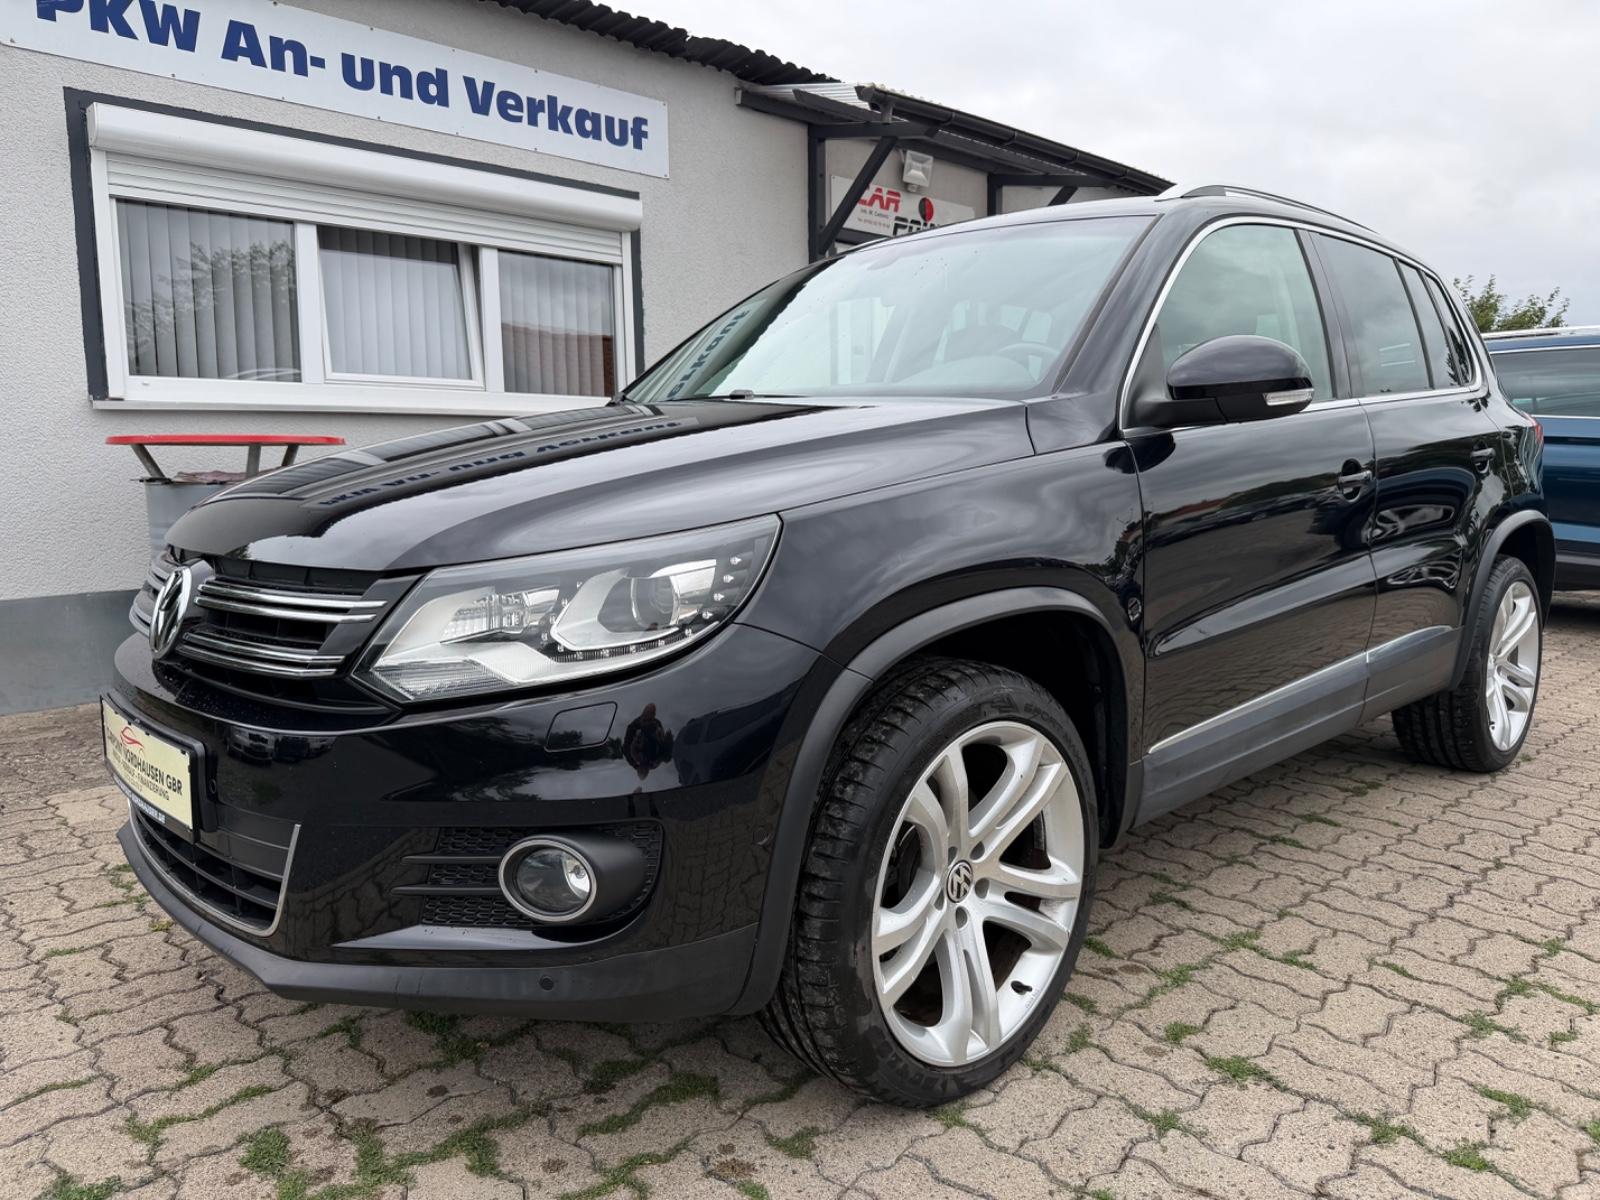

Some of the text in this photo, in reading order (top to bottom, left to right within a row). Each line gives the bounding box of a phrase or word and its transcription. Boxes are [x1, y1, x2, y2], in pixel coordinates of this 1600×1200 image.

[36, 0, 649, 151] PKW An- und Verkauf
[165, 771, 183, 796] GBR
